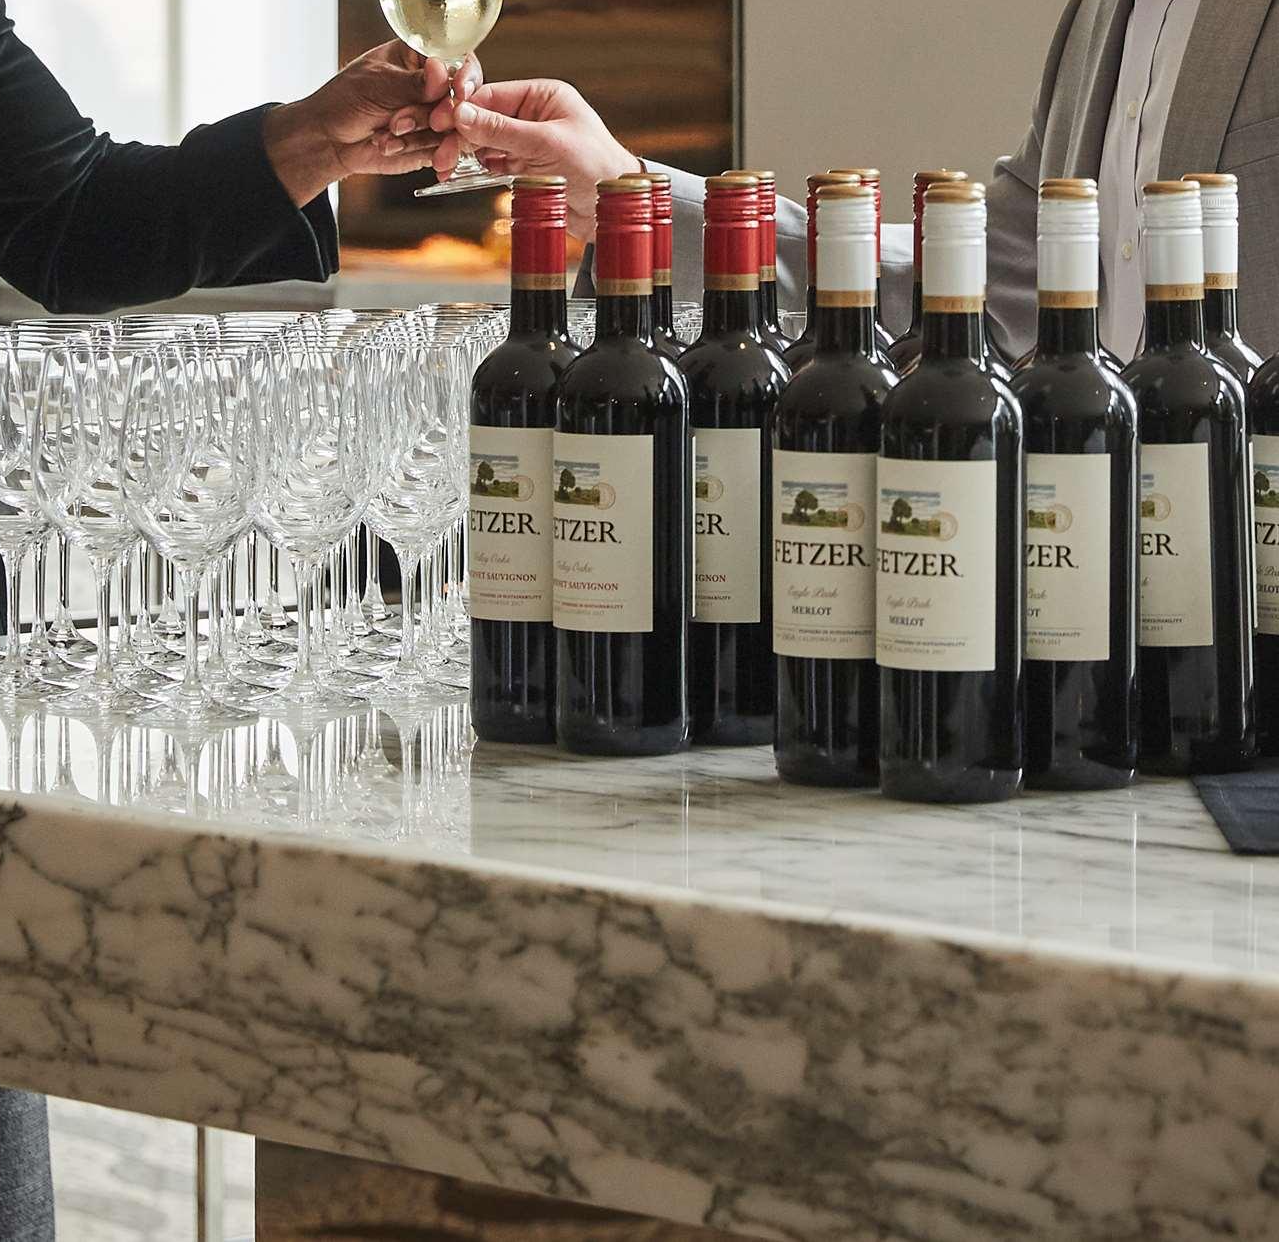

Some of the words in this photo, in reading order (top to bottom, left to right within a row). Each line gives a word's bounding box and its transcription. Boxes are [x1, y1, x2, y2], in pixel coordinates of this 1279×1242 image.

[553, 517, 621, 544] ETZER.
[487, 572, 537, 582] SAUVIGNON
[791, 605, 832, 616] MERLOT
